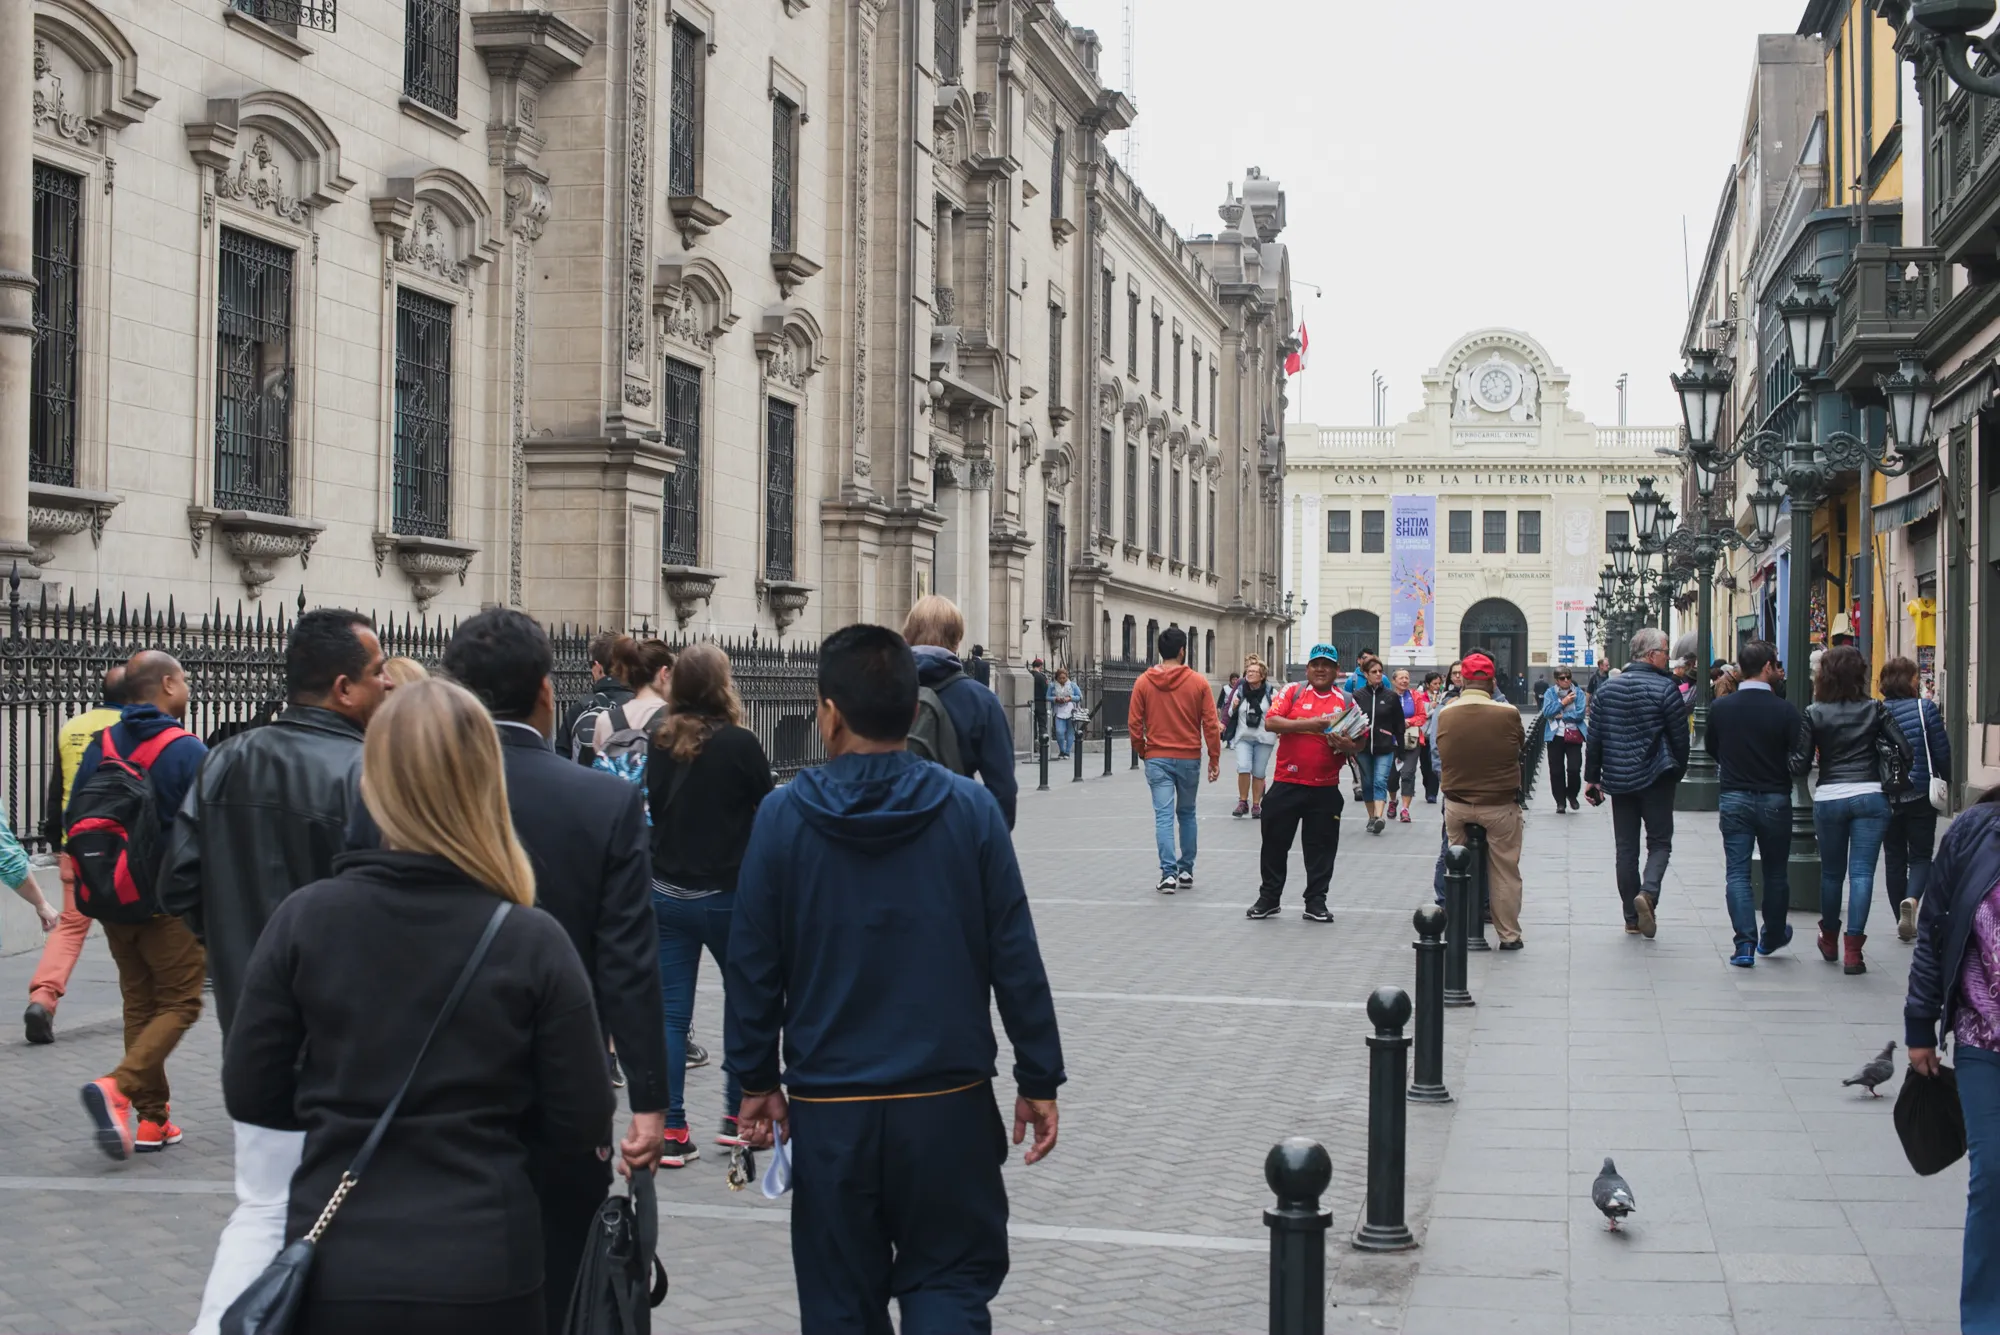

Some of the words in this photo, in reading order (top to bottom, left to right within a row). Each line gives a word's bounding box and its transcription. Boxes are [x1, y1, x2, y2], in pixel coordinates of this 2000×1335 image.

[1334, 474, 1377, 485] CASA
[1406, 474, 1425, 484] DE
[1440, 474, 1460, 484] LA
[1475, 474, 1586, 484] LITERATURA
[1601, 474, 1670, 484] PERUNA
[1396, 517, 1429, 527] SHTIM
[1396, 527, 1429, 537] SHLIM
